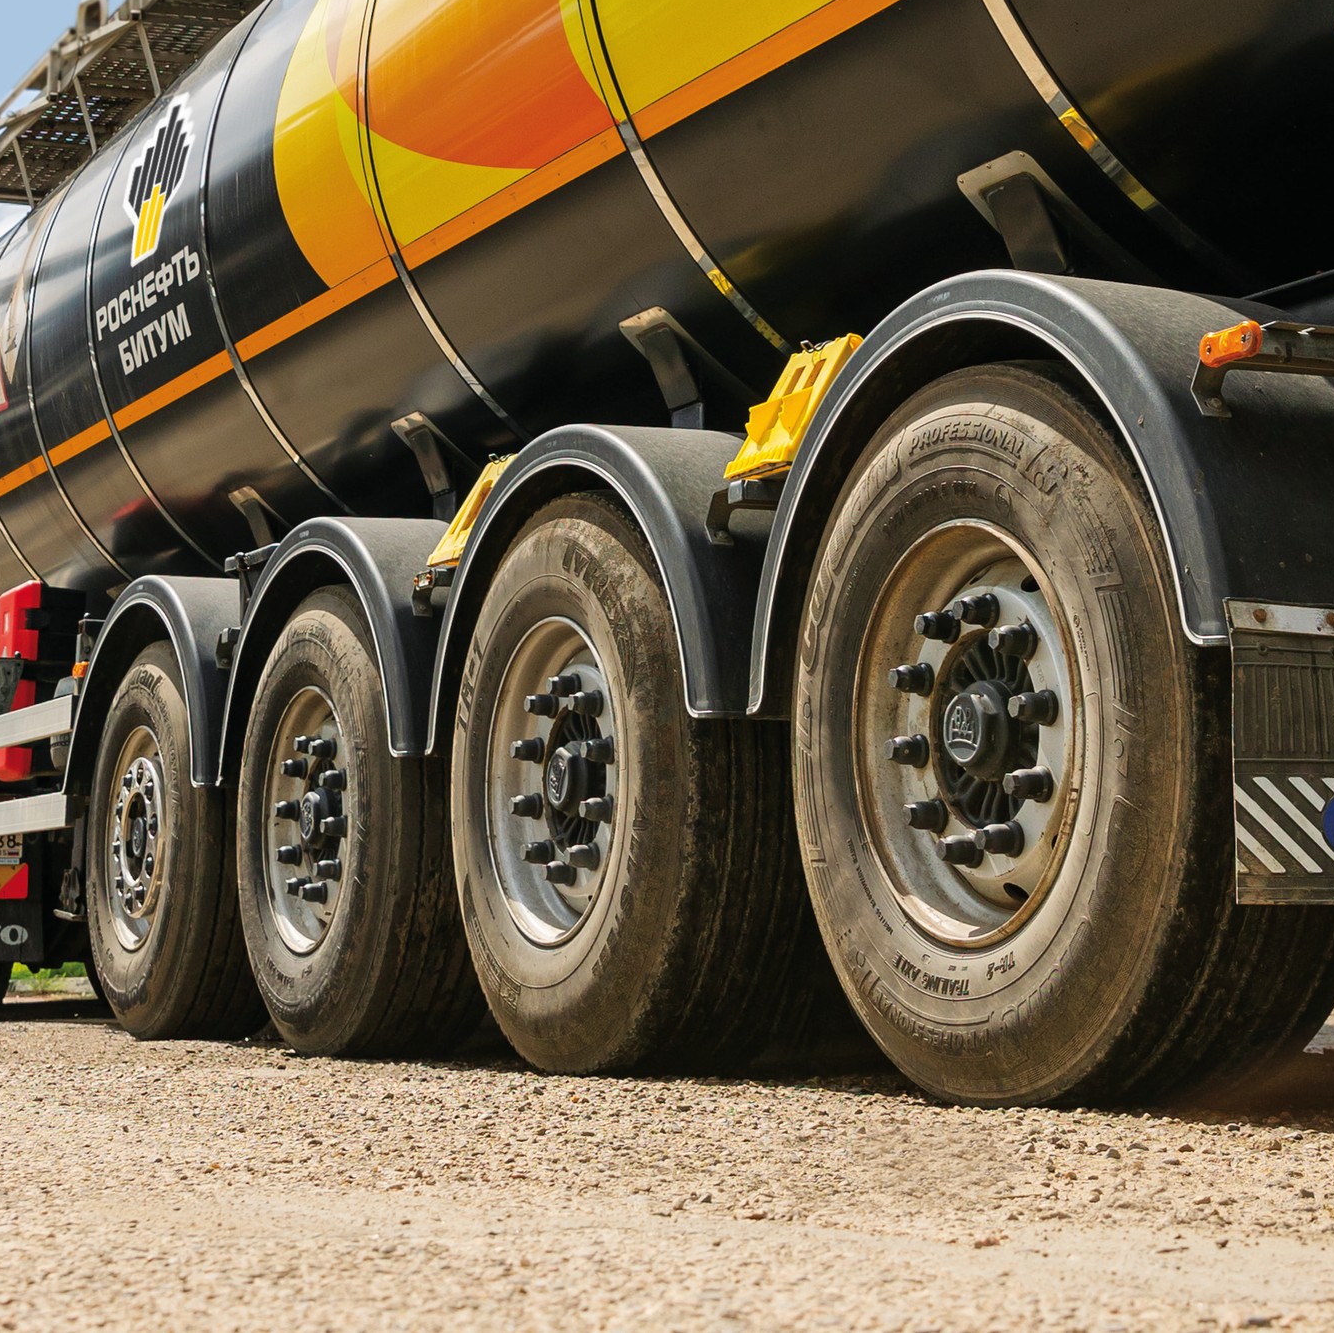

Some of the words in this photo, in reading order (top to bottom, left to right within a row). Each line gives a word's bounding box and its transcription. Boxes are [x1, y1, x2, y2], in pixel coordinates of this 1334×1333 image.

[95, 245, 200, 341] РОСНЕФТЬ
[118, 302, 192, 375] БИТУМ
[908, 420, 1028, 460] PROFESSIONAL
[920, 967, 970, 997] TRAILING
